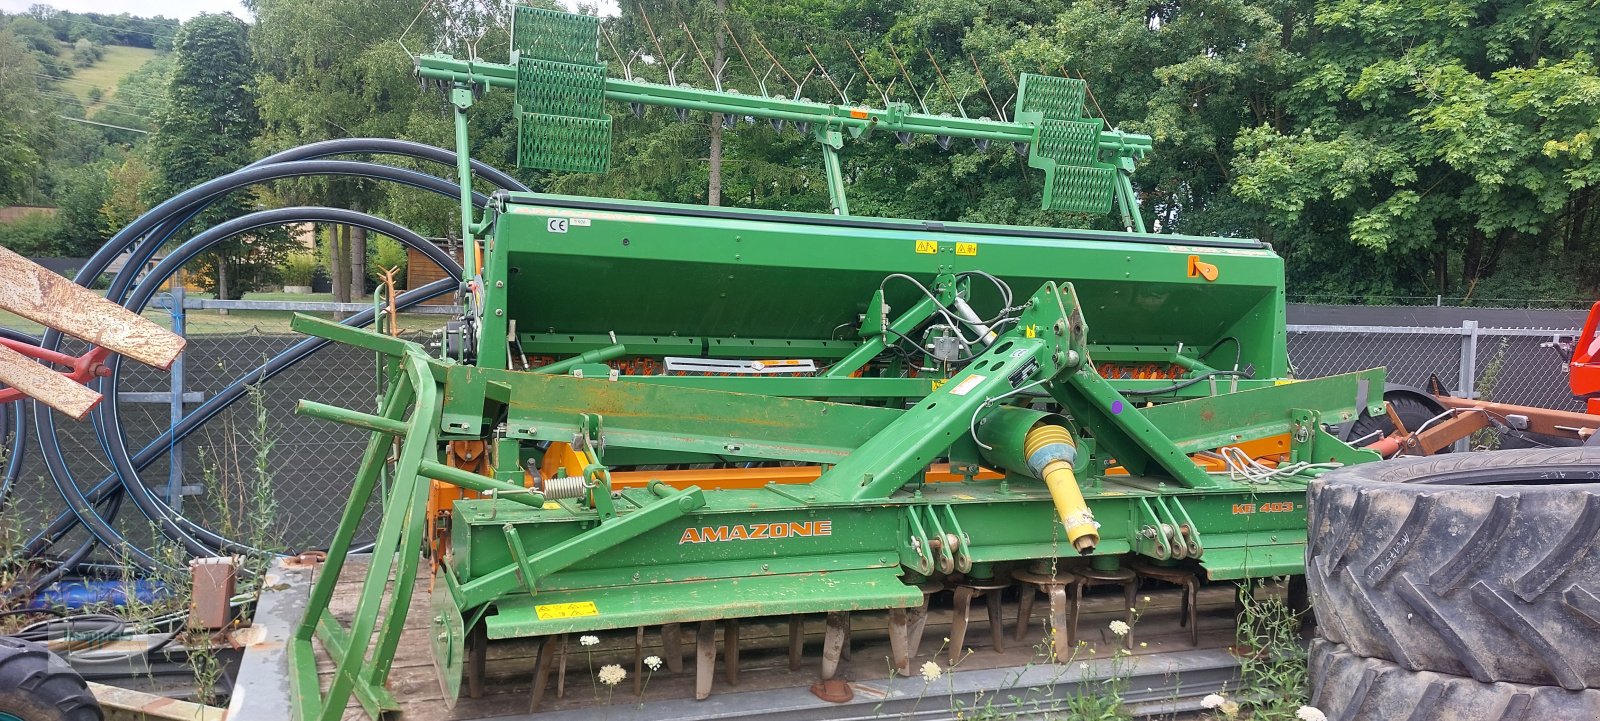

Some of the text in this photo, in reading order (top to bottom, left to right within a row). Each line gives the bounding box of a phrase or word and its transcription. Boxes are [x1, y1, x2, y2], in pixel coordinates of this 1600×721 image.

[549, 219, 566, 231] CE
[1232, 503, 1256, 515] KE
[1259, 501, 1294, 513] 403
[679, 520, 832, 545] AMAZONE
